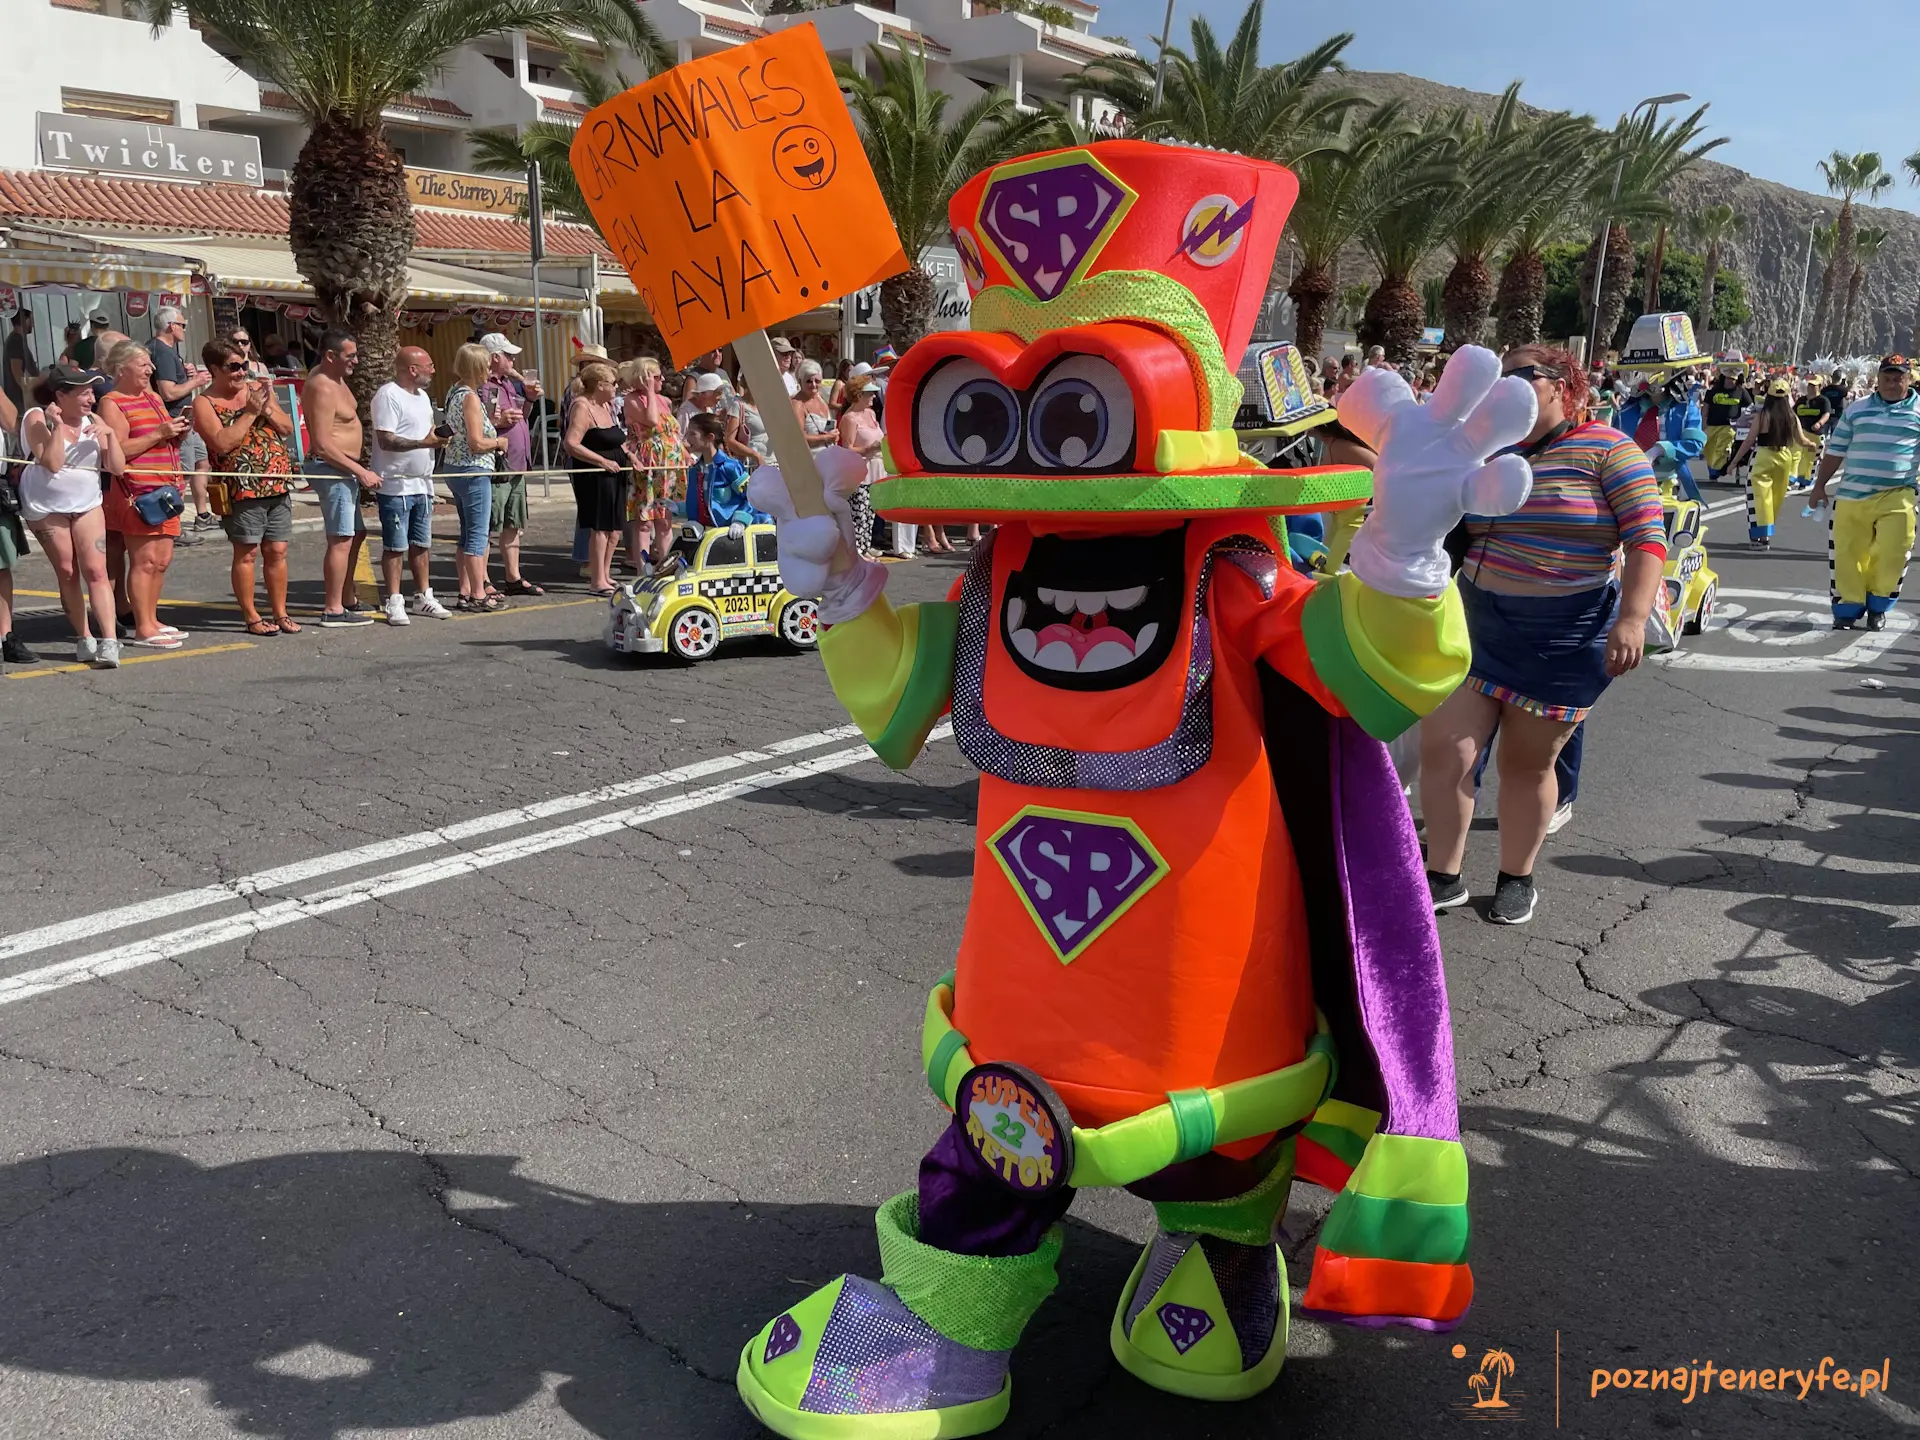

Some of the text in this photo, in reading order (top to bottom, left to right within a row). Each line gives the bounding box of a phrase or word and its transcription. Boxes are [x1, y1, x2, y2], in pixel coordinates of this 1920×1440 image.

[579, 56, 805, 201] CARNAVALES
[47, 130, 258, 180] Twickers
[415, 173, 529, 209] The Surrey Arm
[612, 169, 752, 272] EN LA
[919, 260, 955, 277] KET
[724, 596, 750, 613] 2023
[971, 1075, 1055, 1149] SUPER
[991, 1111, 1026, 1149] 22
[965, 1109, 1055, 1188] RETOR
